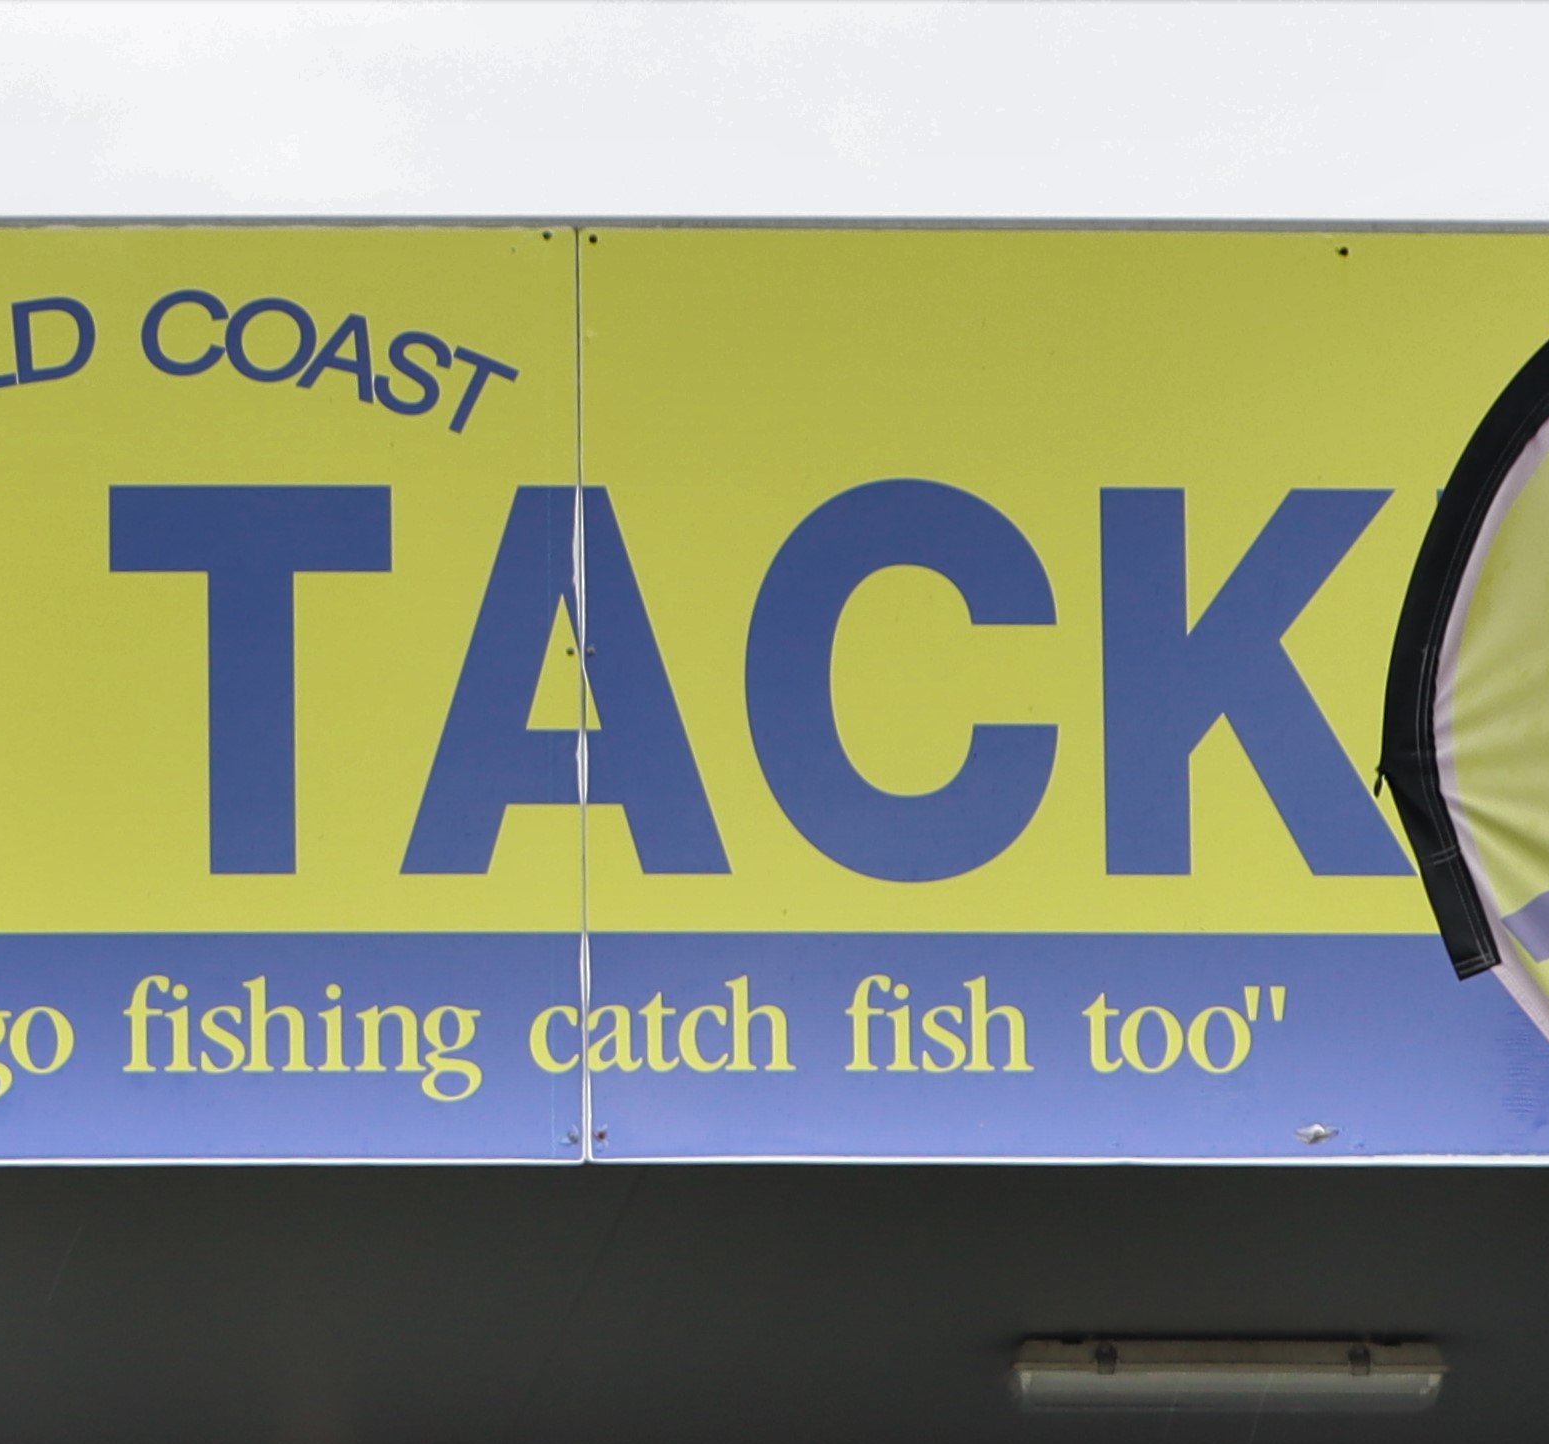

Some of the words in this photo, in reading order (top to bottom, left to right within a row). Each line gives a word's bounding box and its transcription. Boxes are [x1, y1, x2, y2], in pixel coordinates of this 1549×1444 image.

[141, 289, 520, 434] COAST
[109, 477, 1451, 884] TACK
[123, 974, 483, 1103] fishing
[528, 974, 797, 1074] catch
[844, 974, 1035, 1074] fish
[1082, 984, 1288, 1075] too"
